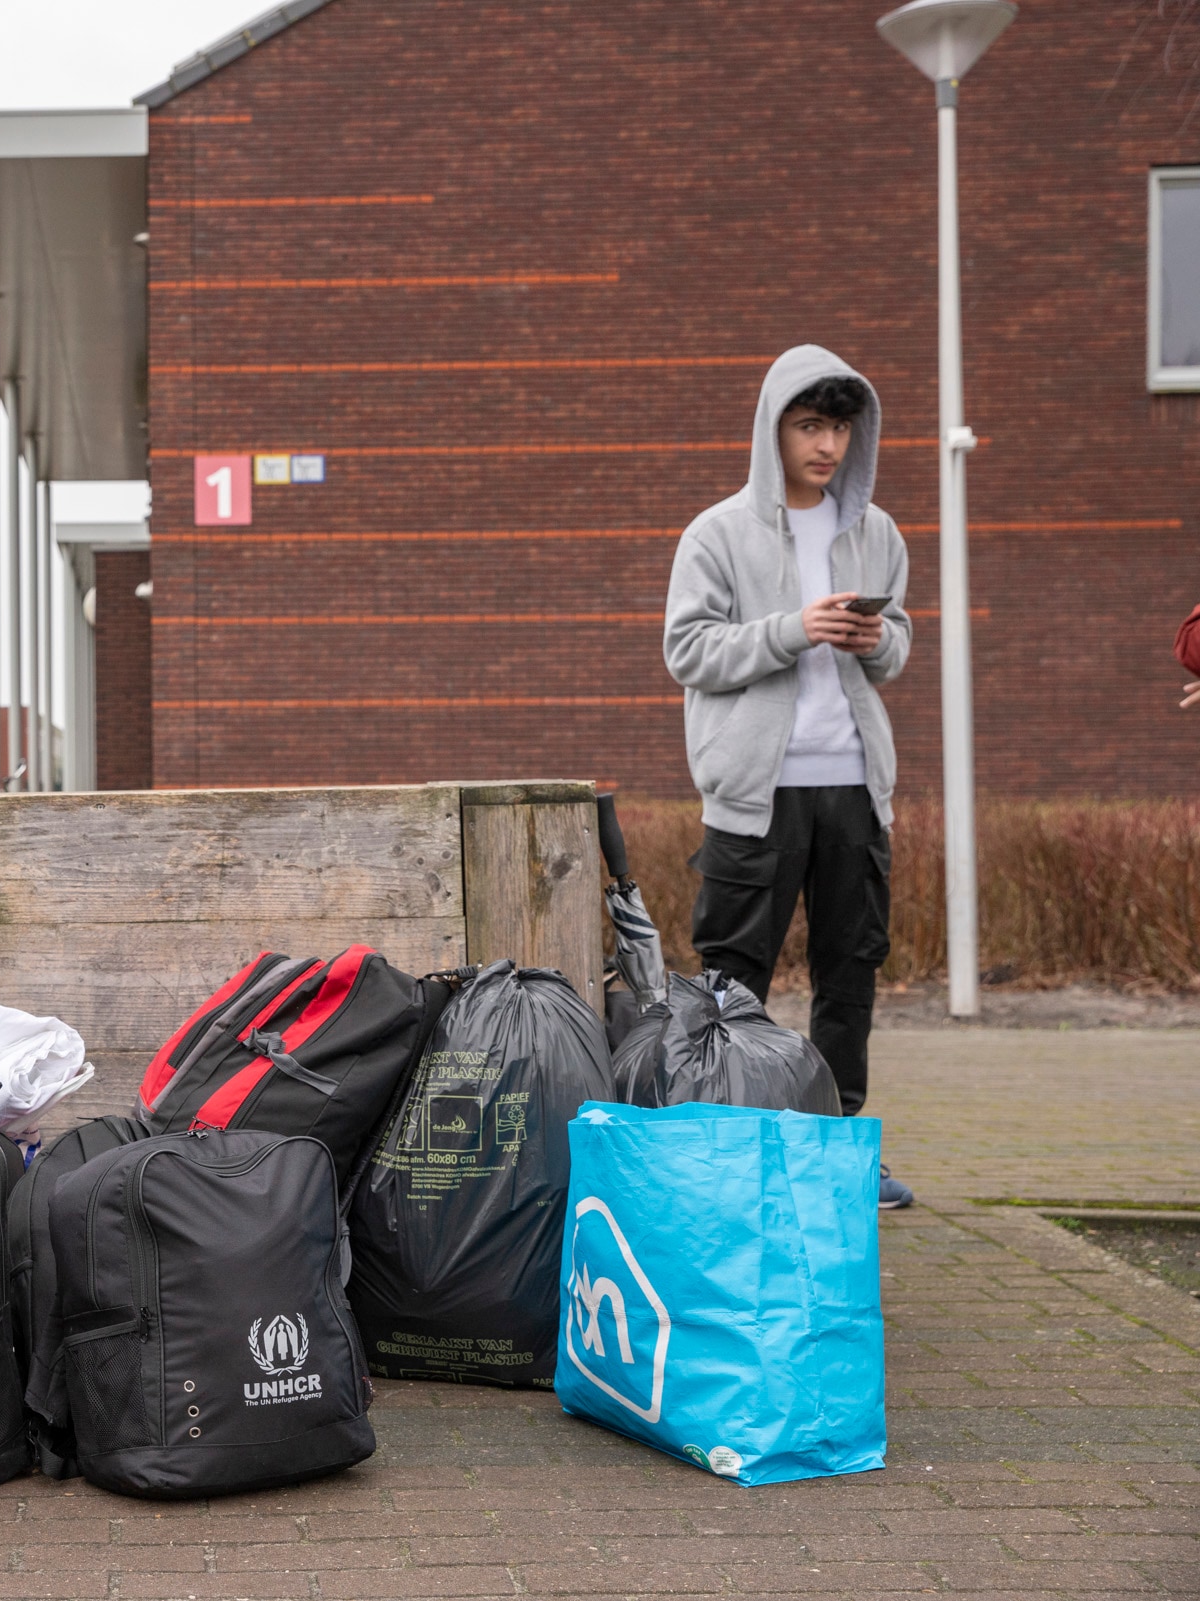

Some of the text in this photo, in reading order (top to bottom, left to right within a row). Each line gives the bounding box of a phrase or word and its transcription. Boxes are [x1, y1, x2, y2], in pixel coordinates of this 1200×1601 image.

[205, 466, 232, 519] 1
[453, 1052, 489, 1064] VAN
[427, 1153, 457, 1165] 60x80
[460, 1154, 476, 1164] cm
[392, 1331, 513, 1352] GEMAAKT VAN
[376, 1340, 534, 1367] GEBRUIKT PLASTIC
[243, 1373, 322, 1400] UNHCR
[272, 1395, 299, 1404] Refugee
[299, 1391, 323, 1401] Agency
